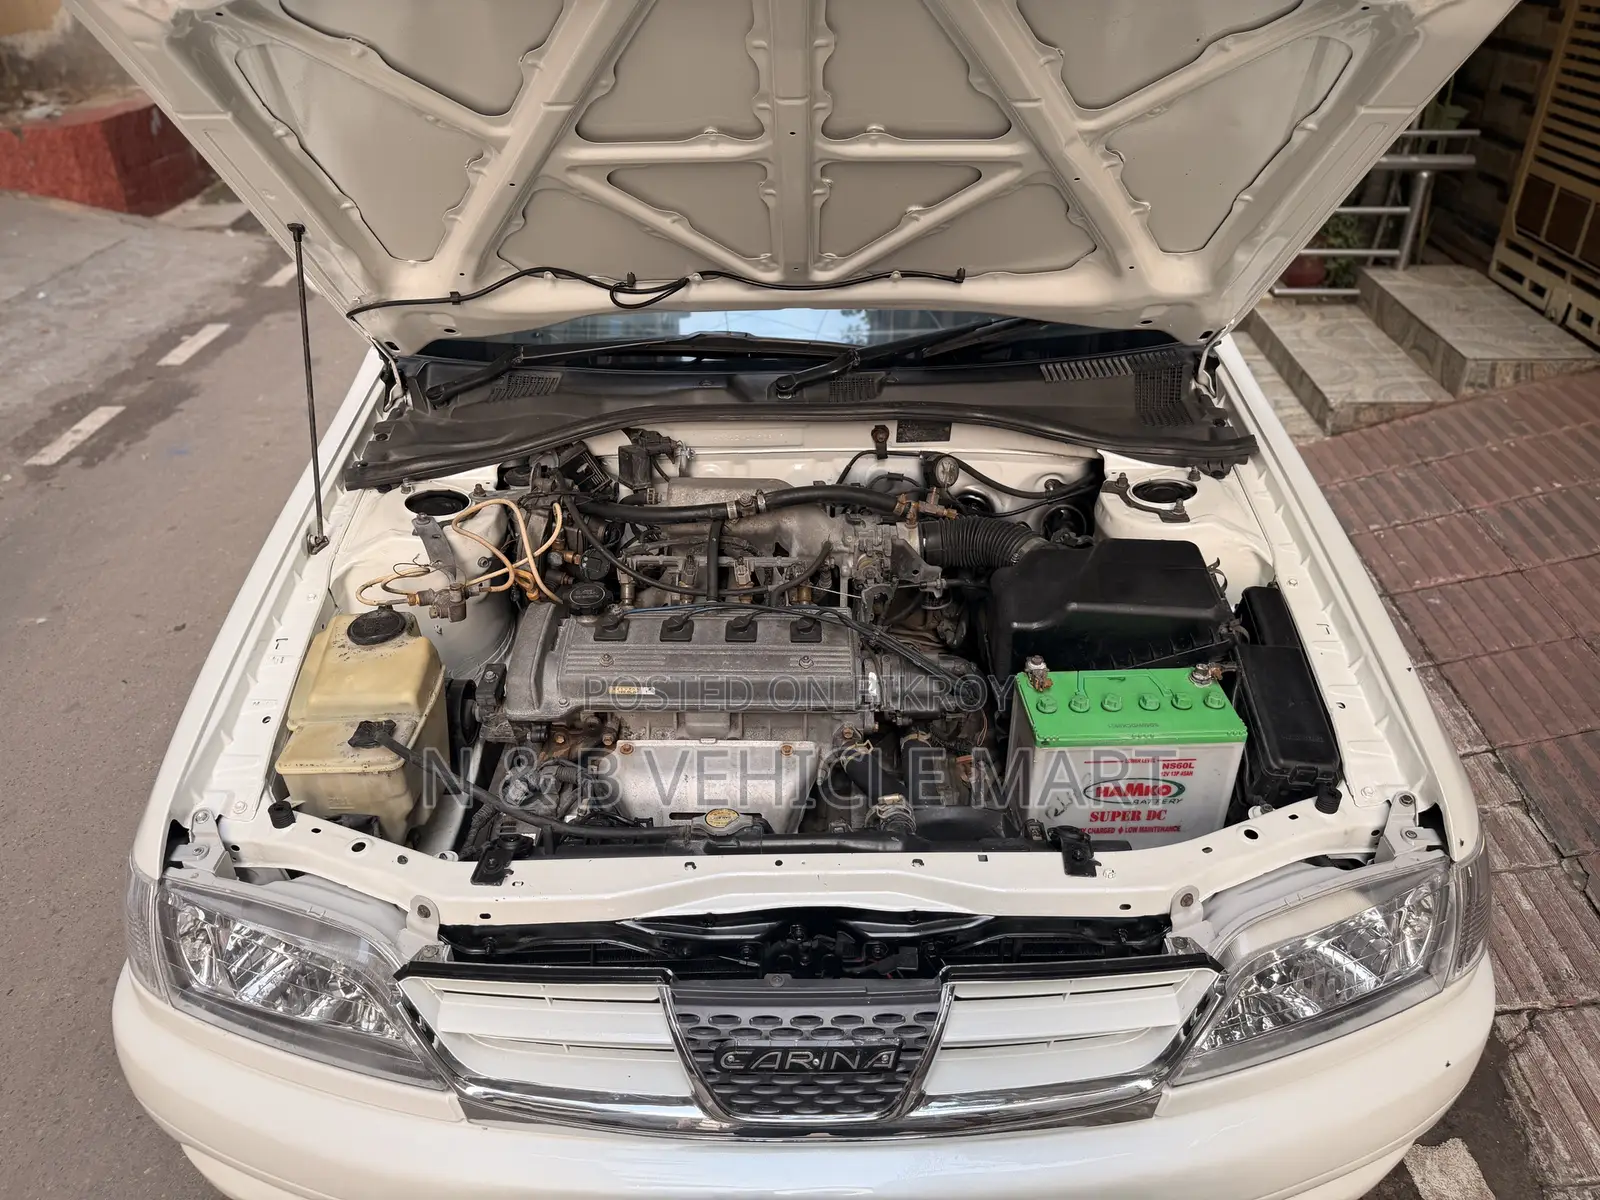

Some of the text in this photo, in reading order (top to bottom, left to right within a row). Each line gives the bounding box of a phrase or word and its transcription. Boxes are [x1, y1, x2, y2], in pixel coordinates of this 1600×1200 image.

[1162, 762, 1194, 770] NS60L
[1095, 783, 1172, 797] HAMKO
[1089, 809, 1168, 822] SUPER DC
[720, 1050, 896, 1070] CARINA
